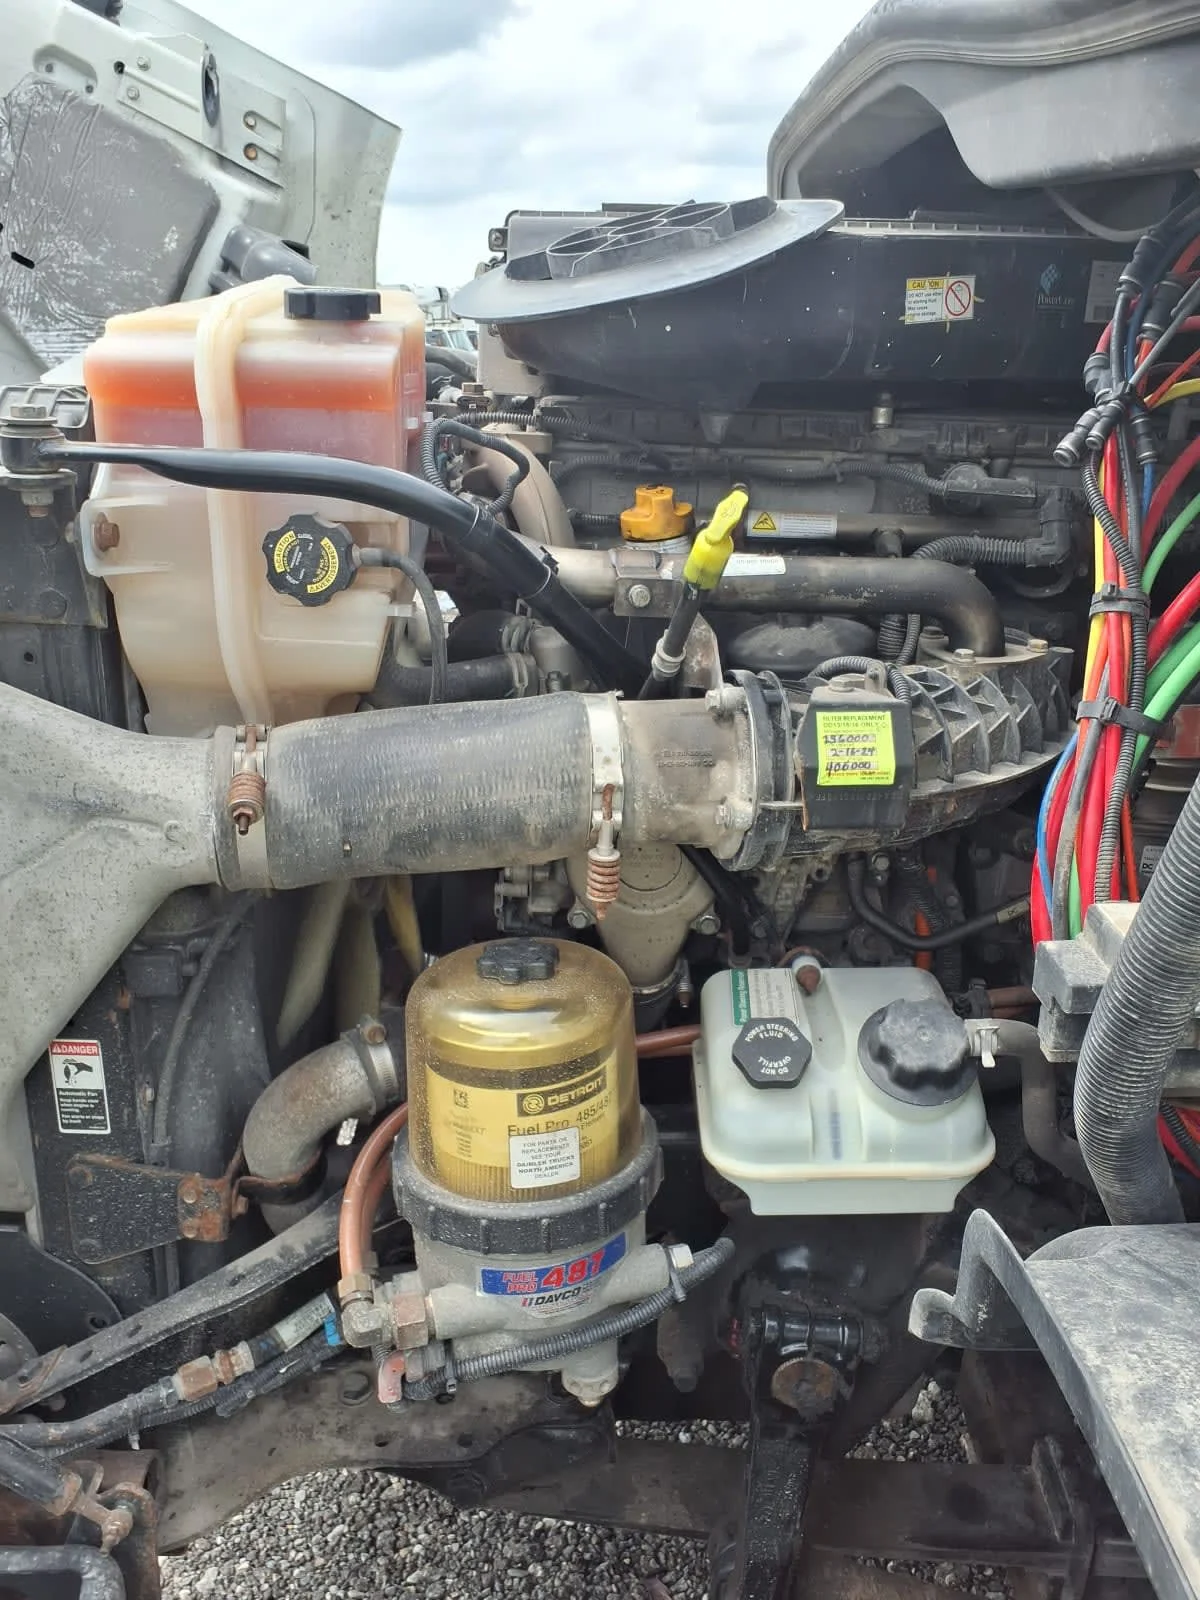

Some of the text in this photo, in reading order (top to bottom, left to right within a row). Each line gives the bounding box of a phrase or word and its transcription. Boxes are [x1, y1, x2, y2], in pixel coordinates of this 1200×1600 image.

[911, 280, 940, 289] CAUION
[275, 533, 296, 567] CAUTION
[745, 1023, 799, 1042] POWER STEERING
[759, 1030, 783, 1039] FLUID
[61, 1046, 98, 1054] DANGER
[758, 1055, 792, 1068] OVERFILL
[761, 1066, 789, 1075] DO NOT
[548, 1077, 602, 1105] DETROIT
[507, 1123, 540, 1137] Fuel
[545, 1118, 569, 1131] Pro
[516, 1155, 575, 1168] DAIMLER TRUCKS
[544, 1161, 574, 1172] AMERICA
[541, 1249, 604, 1289] 487
[503, 1271, 538, 1282] FUEL
[507, 1282, 537, 1293] PRO
[534, 1286, 582, 1306] DAVCO
